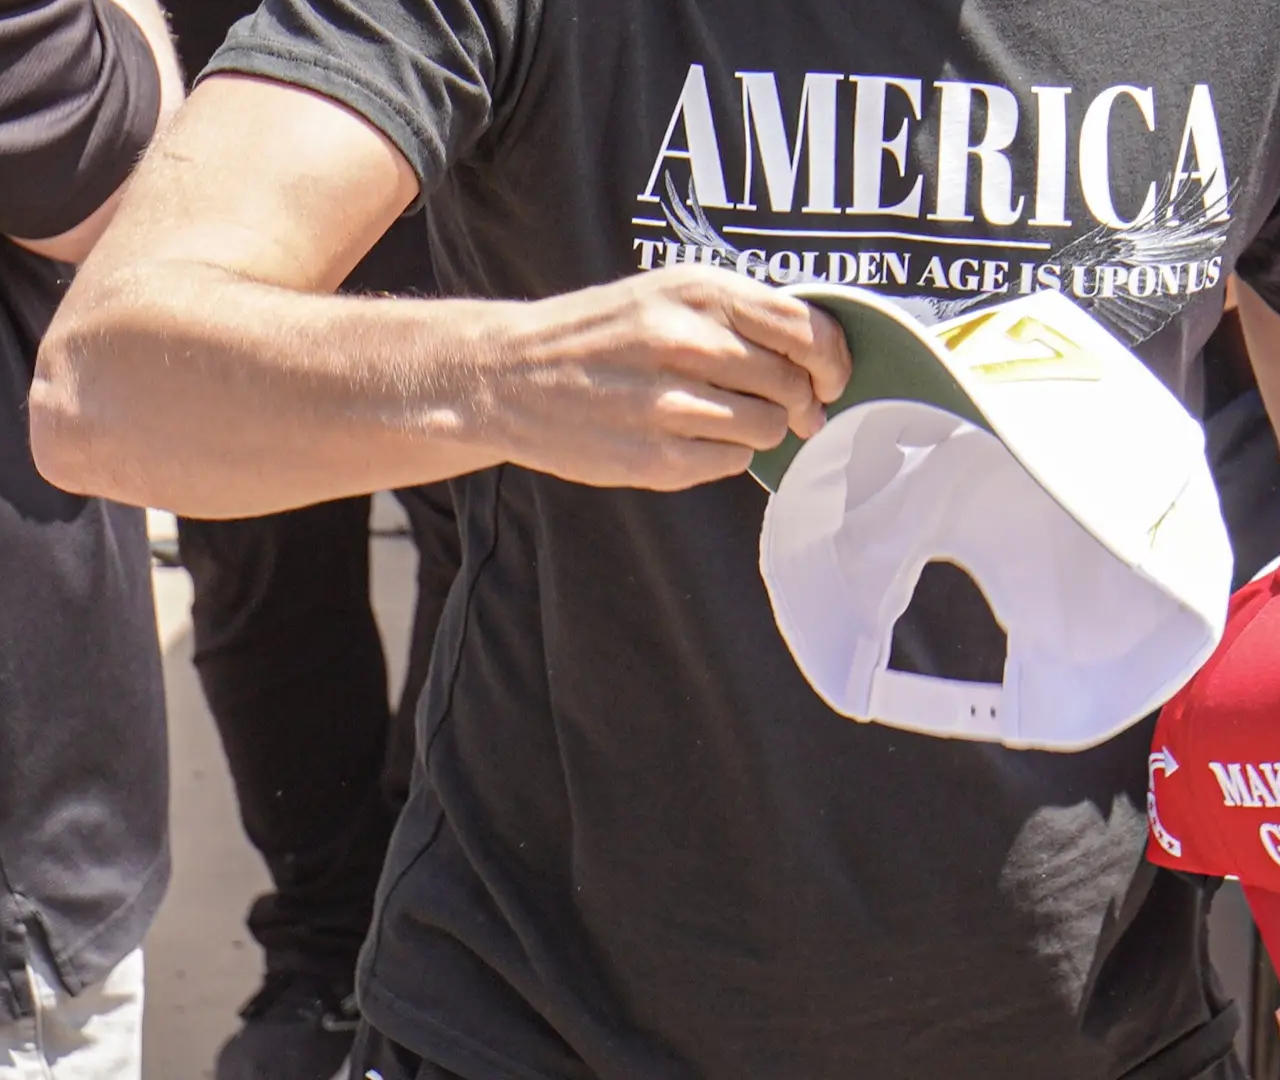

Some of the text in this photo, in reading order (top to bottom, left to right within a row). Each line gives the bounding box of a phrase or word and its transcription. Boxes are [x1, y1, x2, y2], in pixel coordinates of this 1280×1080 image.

[637, 63, 1231, 230] AMERICA
[632, 238, 1222, 299] THE GOLDEN AGE IS UPON US
